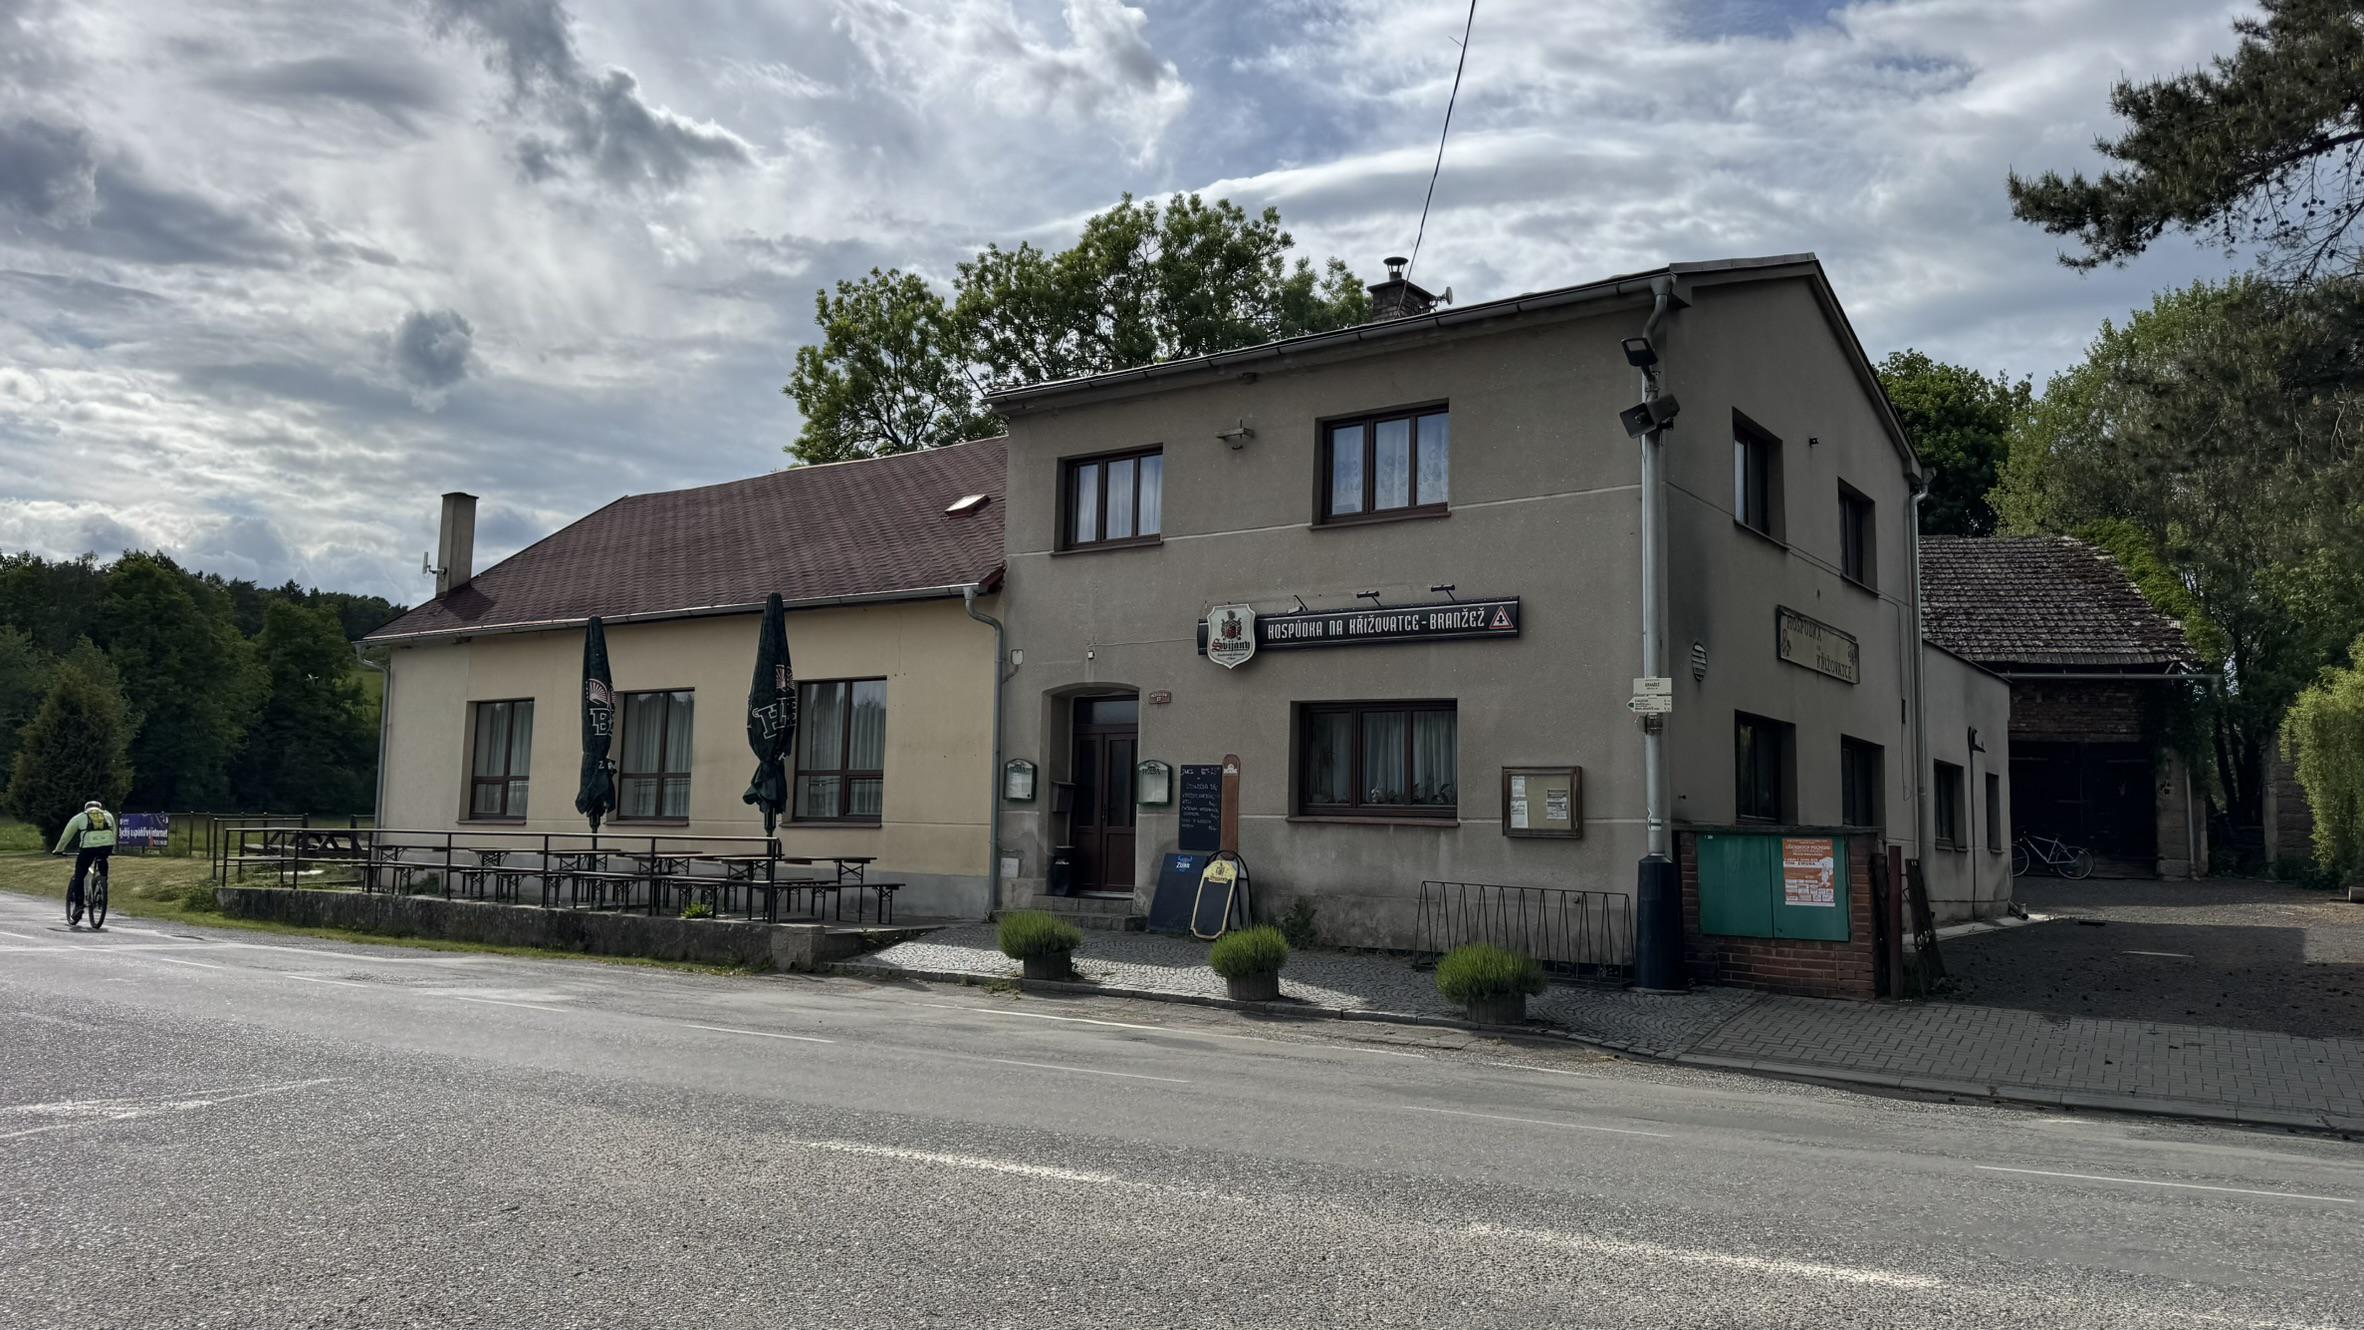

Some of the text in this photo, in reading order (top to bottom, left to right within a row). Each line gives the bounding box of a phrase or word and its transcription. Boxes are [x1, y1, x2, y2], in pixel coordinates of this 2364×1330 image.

[1267, 620, 1322, 640] HOSPŮDKA
[1329, 619, 1343, 636] NA
[1211, 638, 1250, 653] Svijany
